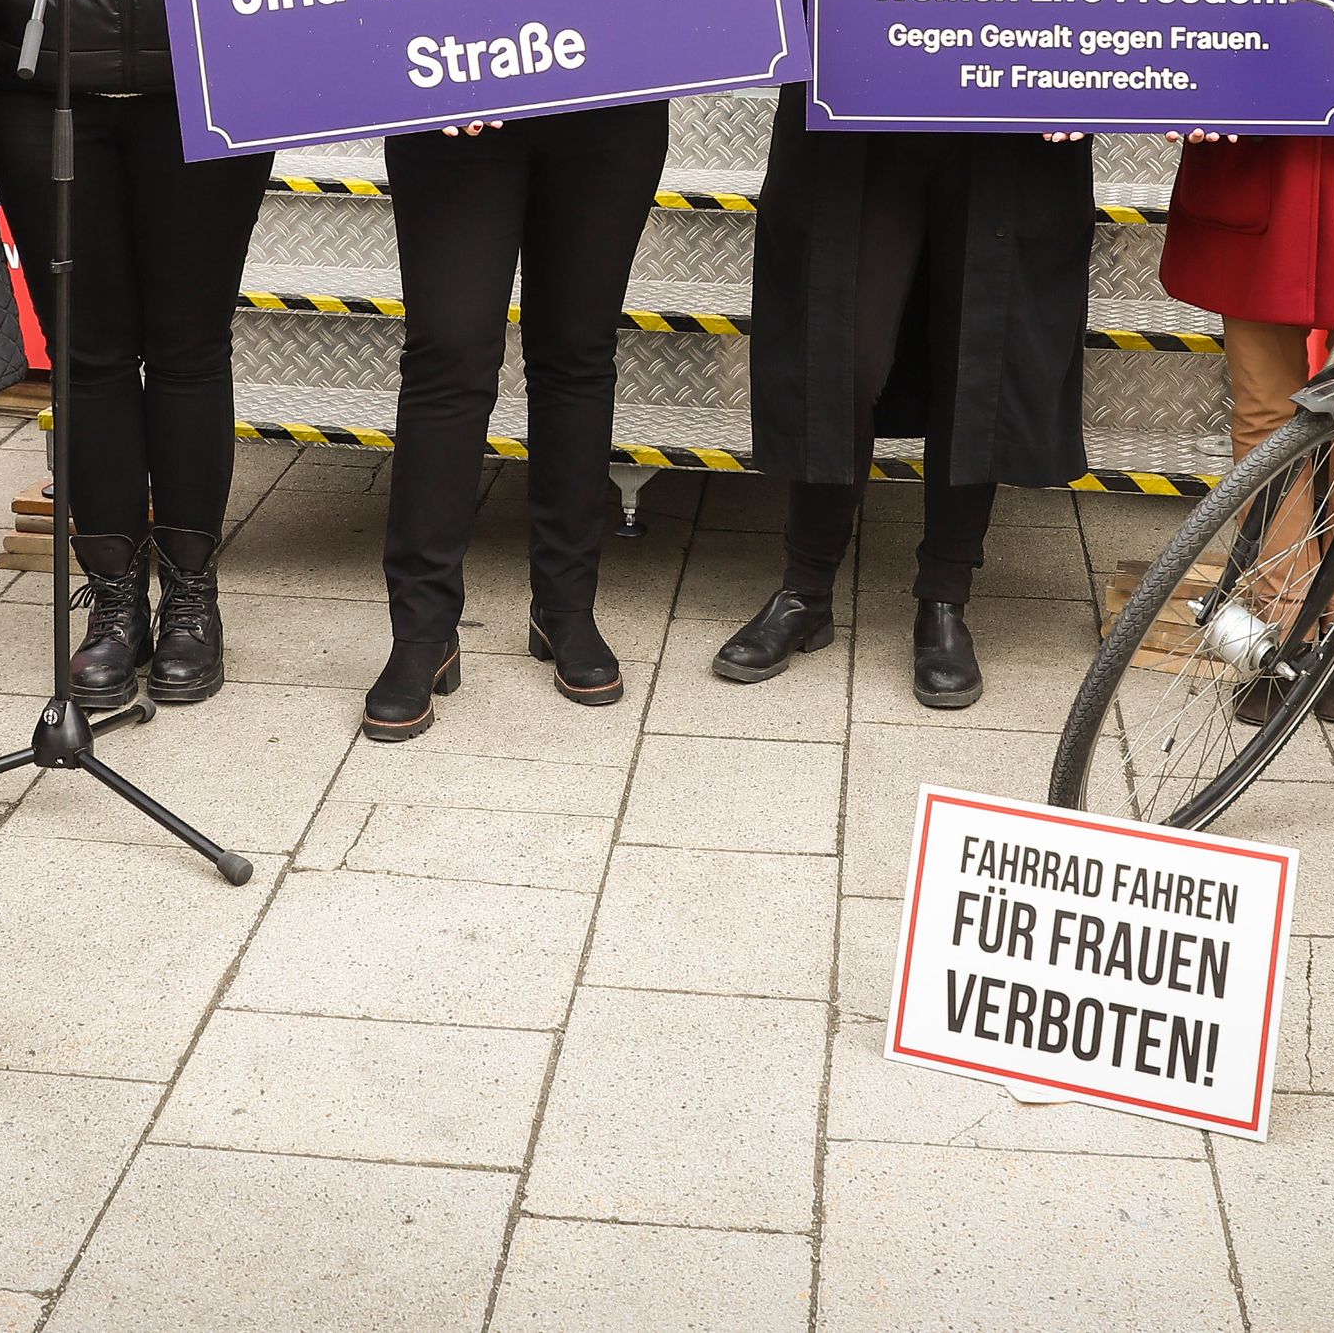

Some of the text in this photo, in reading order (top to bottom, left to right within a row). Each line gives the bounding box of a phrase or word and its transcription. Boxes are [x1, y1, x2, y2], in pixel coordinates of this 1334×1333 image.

[407, 22, 586, 88] Straße
[888, 23, 1269, 56] Gegen Gewalt gegen Frauen.
[960, 64, 1197, 90] Für Frauenrechte.
[960, 835, 1239, 924] FAHRRAD FAHREN
[952, 885, 1231, 1000] FÜR FRAUEN
[946, 968, 1221, 1088] VERBOTEN!
